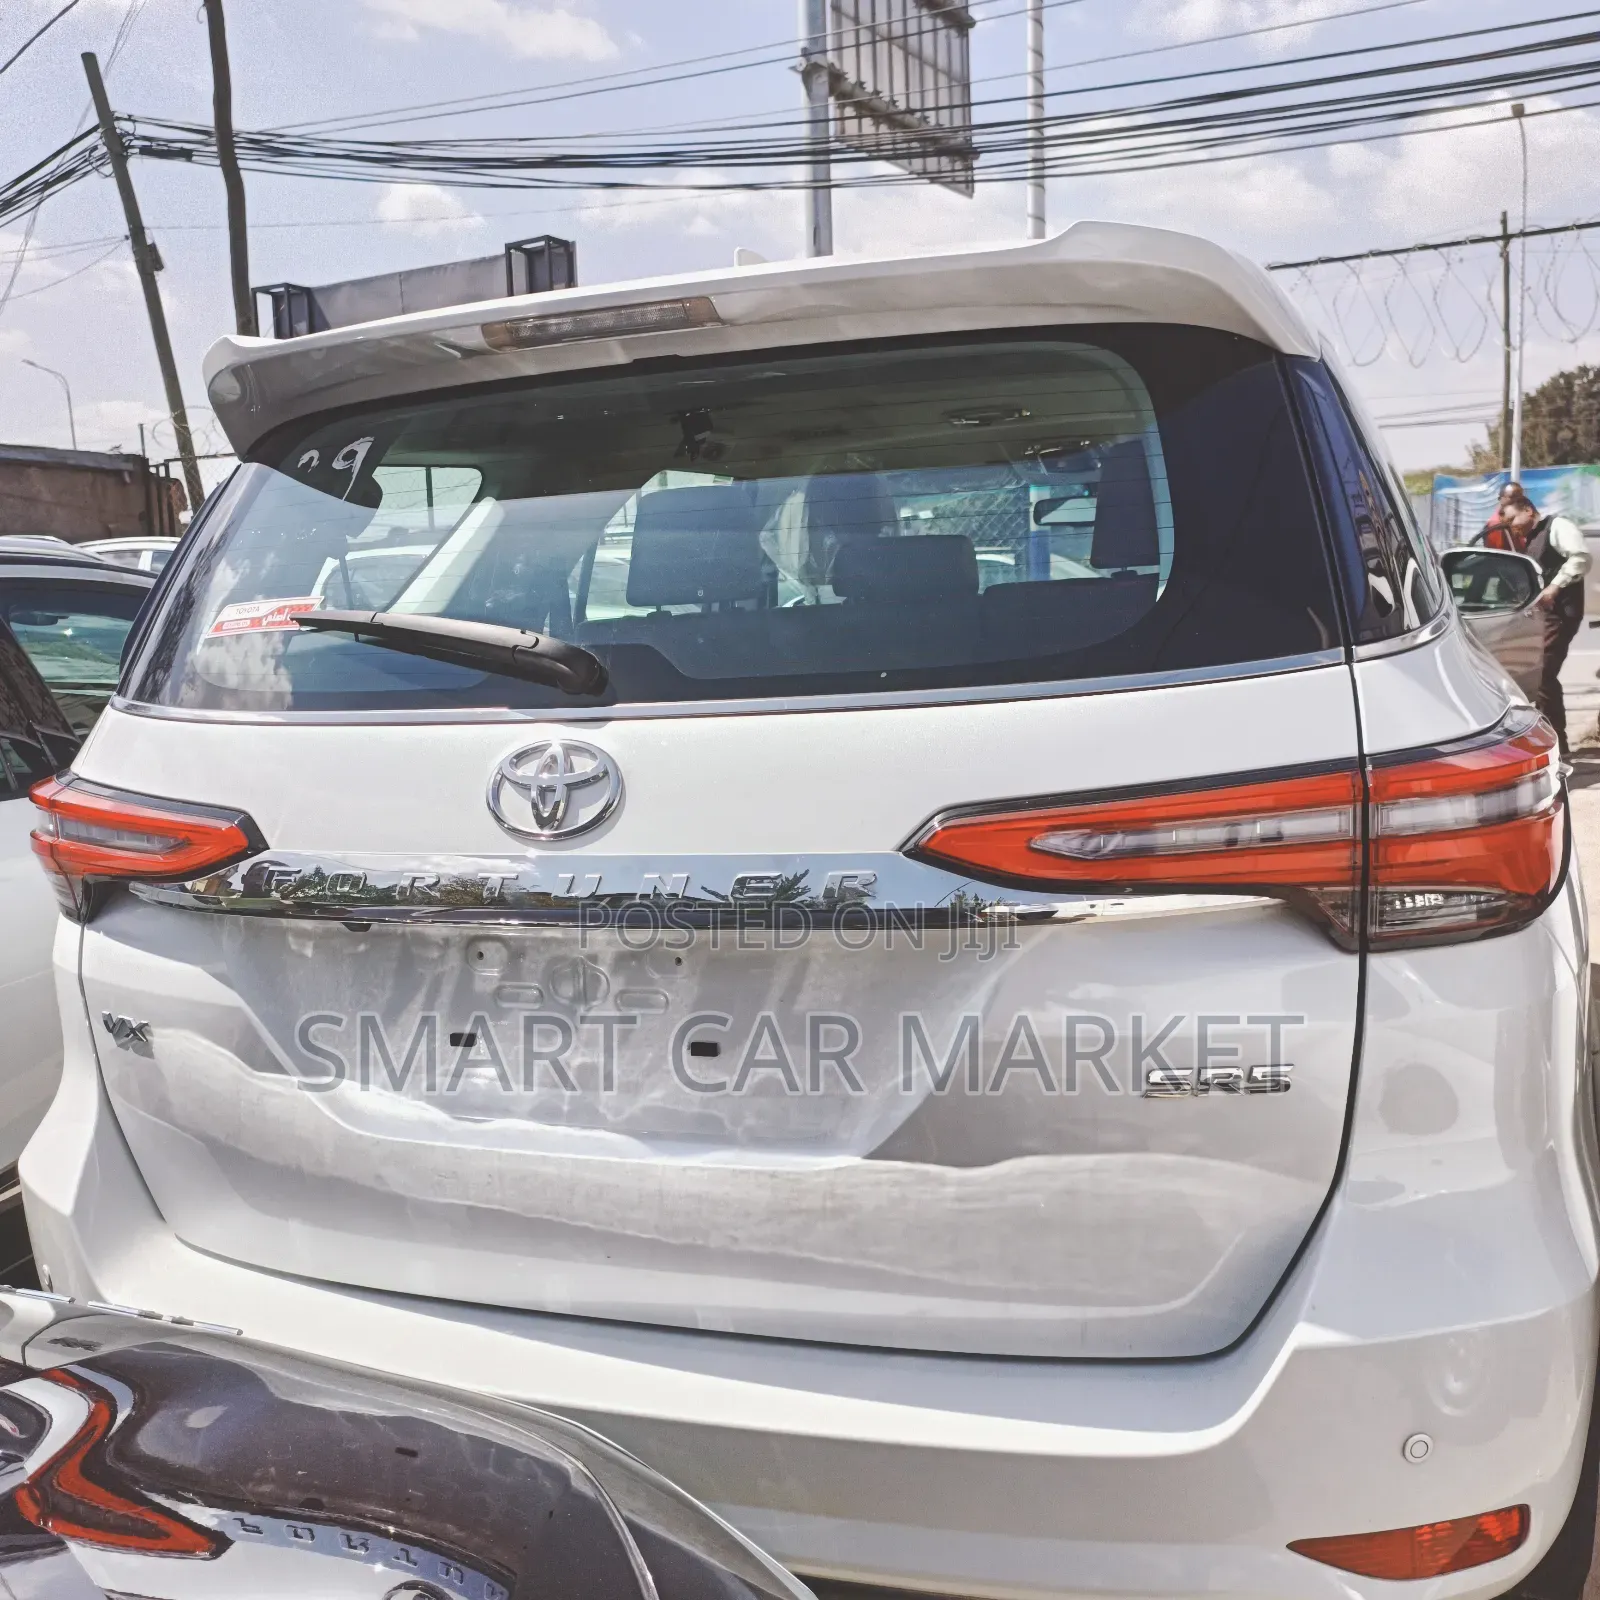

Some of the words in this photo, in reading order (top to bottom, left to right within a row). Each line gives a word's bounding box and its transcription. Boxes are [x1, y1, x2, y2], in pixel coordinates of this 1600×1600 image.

[235, 605, 260, 616] TOYOTA
[261, 866, 879, 902] FORTUNER
[101, 1010, 152, 1045] VX
[1141, 1063, 1296, 1100] SR5
